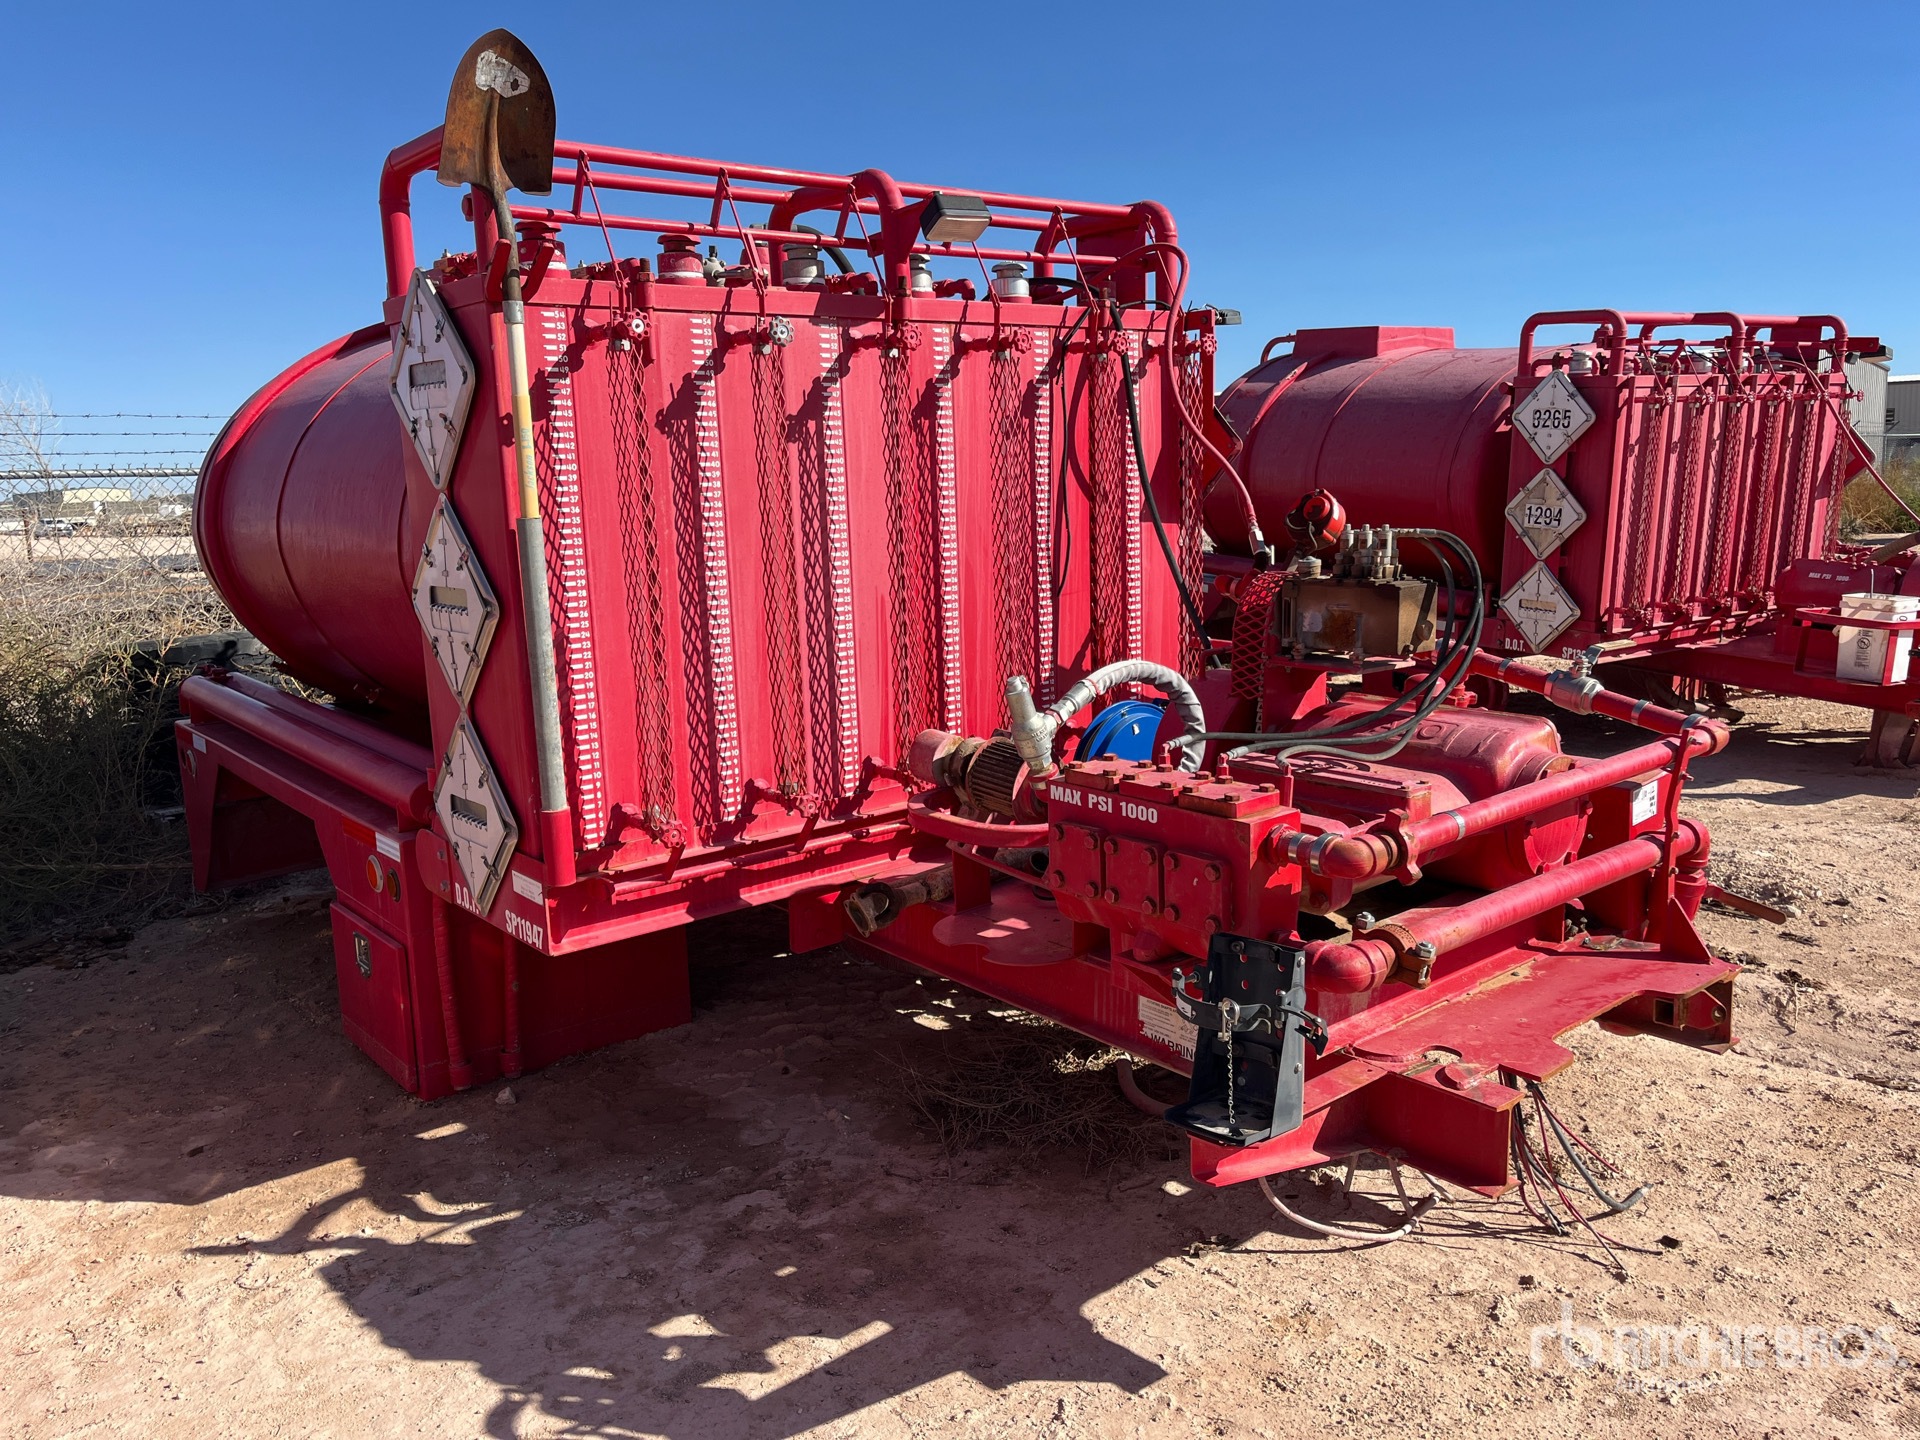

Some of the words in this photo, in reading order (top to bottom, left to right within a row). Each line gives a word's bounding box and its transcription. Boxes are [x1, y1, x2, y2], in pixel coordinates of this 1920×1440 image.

[1533, 410, 1571, 428] 3265
[1526, 506, 1562, 526] 1294
[1505, 638, 1526, 651] D.O.T.
[1050, 785, 1081, 806] MAX
[1088, 793, 1112, 813] PSI
[1120, 802, 1158, 824] 1000
[505, 910, 543, 950] SP11947
